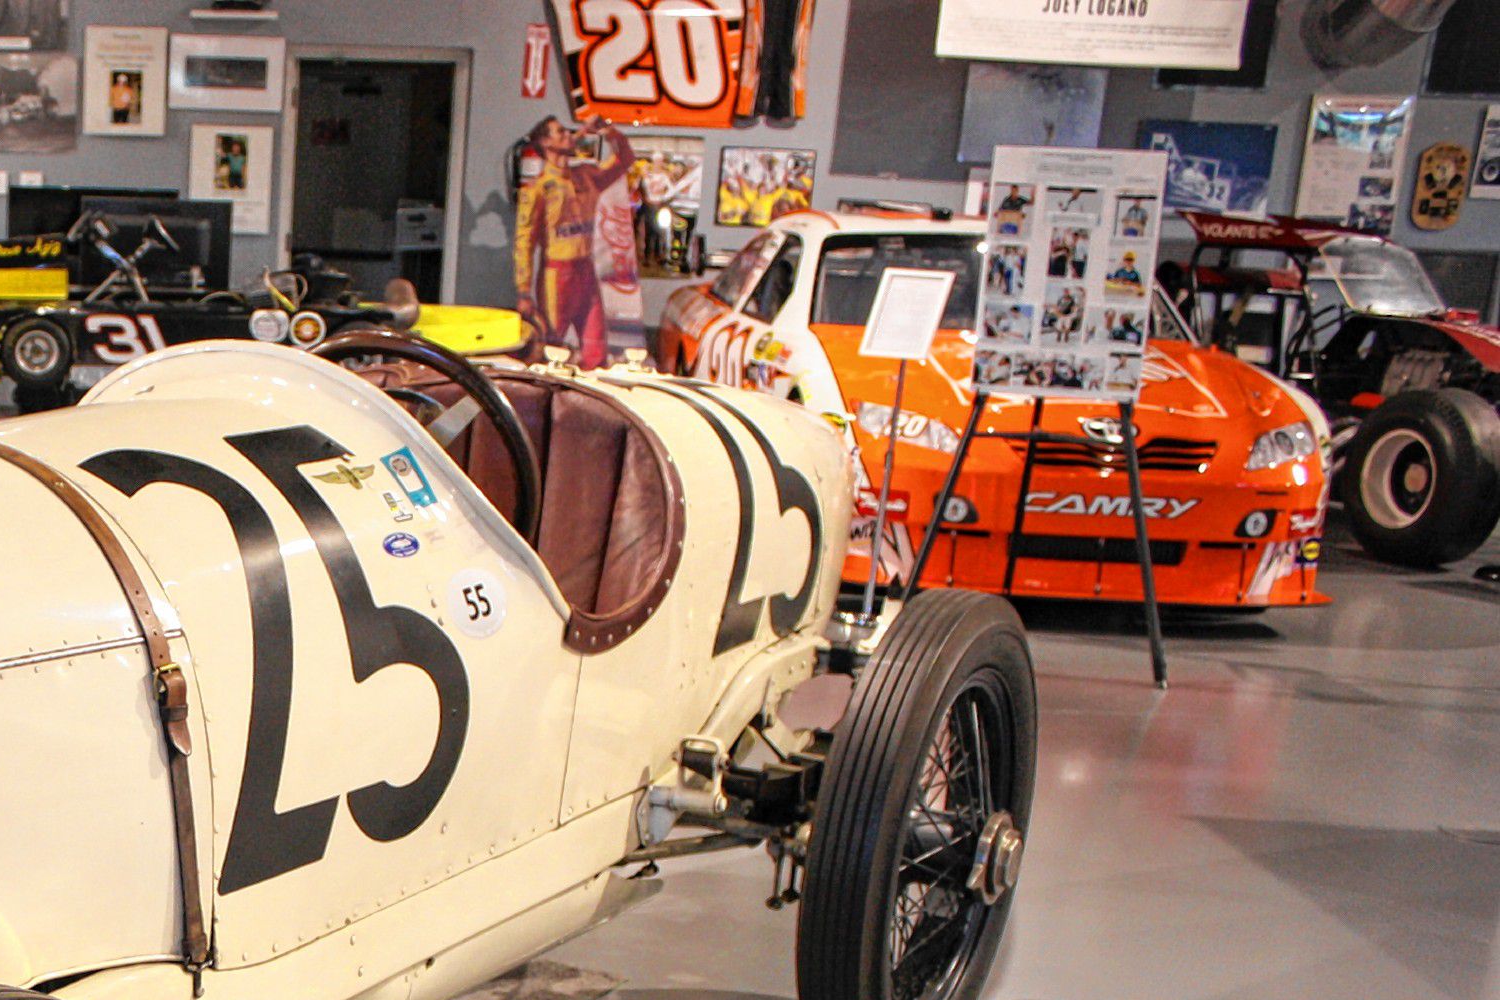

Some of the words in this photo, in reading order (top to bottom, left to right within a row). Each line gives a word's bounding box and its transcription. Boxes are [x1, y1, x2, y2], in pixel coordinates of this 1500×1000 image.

[1041, 0, 1080, 13] JOEY
[1088, 0, 1149, 17] LOGANO
[580, 0, 728, 105] 20
[84, 313, 168, 365] 31
[596, 375, 824, 657] 25
[1023, 491, 1200, 520] CAMRY
[462, 582, 494, 621] 55
[76, 424, 471, 896] 25
